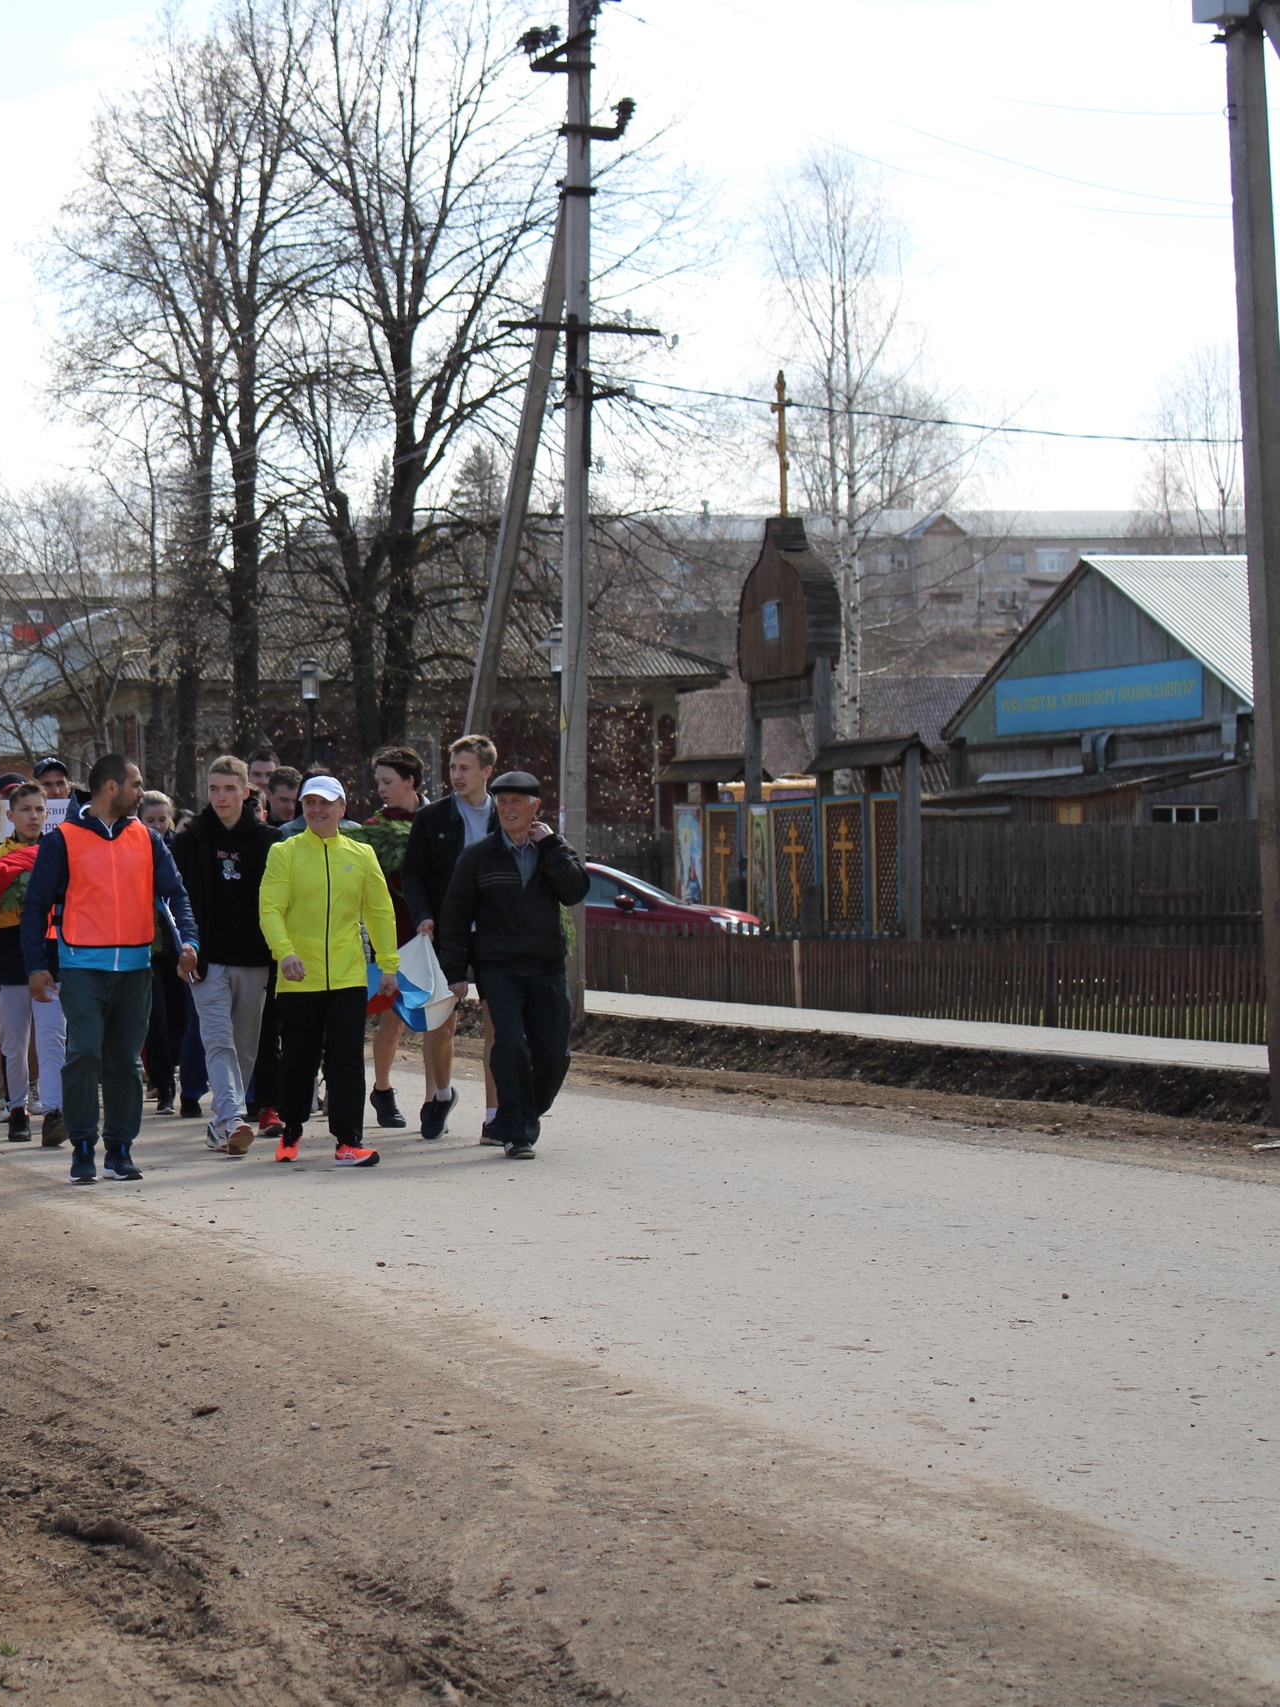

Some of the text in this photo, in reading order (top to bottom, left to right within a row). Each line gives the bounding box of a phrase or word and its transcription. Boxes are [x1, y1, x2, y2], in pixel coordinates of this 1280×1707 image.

[1001, 697, 1022, 718] РУСЬ
[1061, 690, 1091, 708] ХРАНИ
[1093, 687, 1116, 708] ВЕРУ
